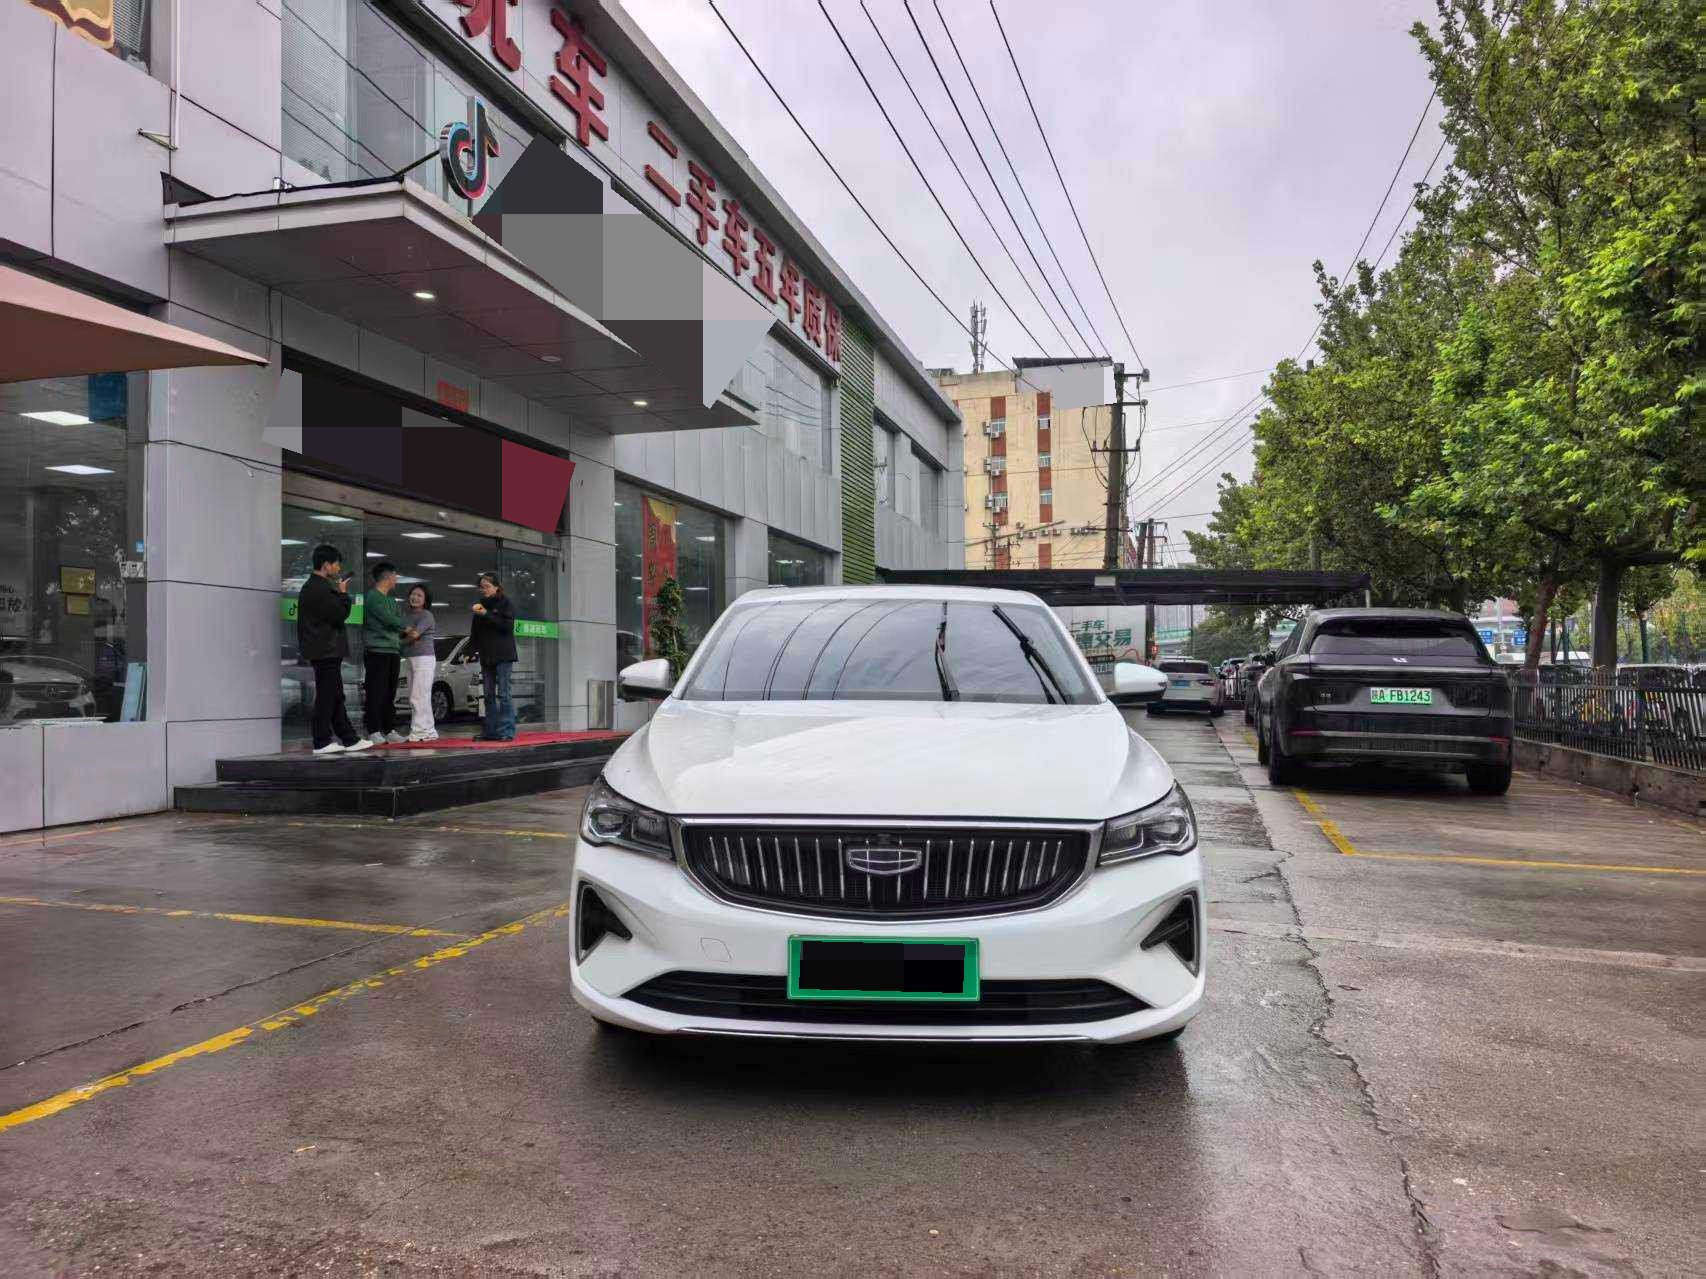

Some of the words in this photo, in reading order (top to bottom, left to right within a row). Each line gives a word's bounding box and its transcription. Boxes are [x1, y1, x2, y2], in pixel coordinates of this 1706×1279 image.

[644, 120, 841, 363] 二手车五年质保
